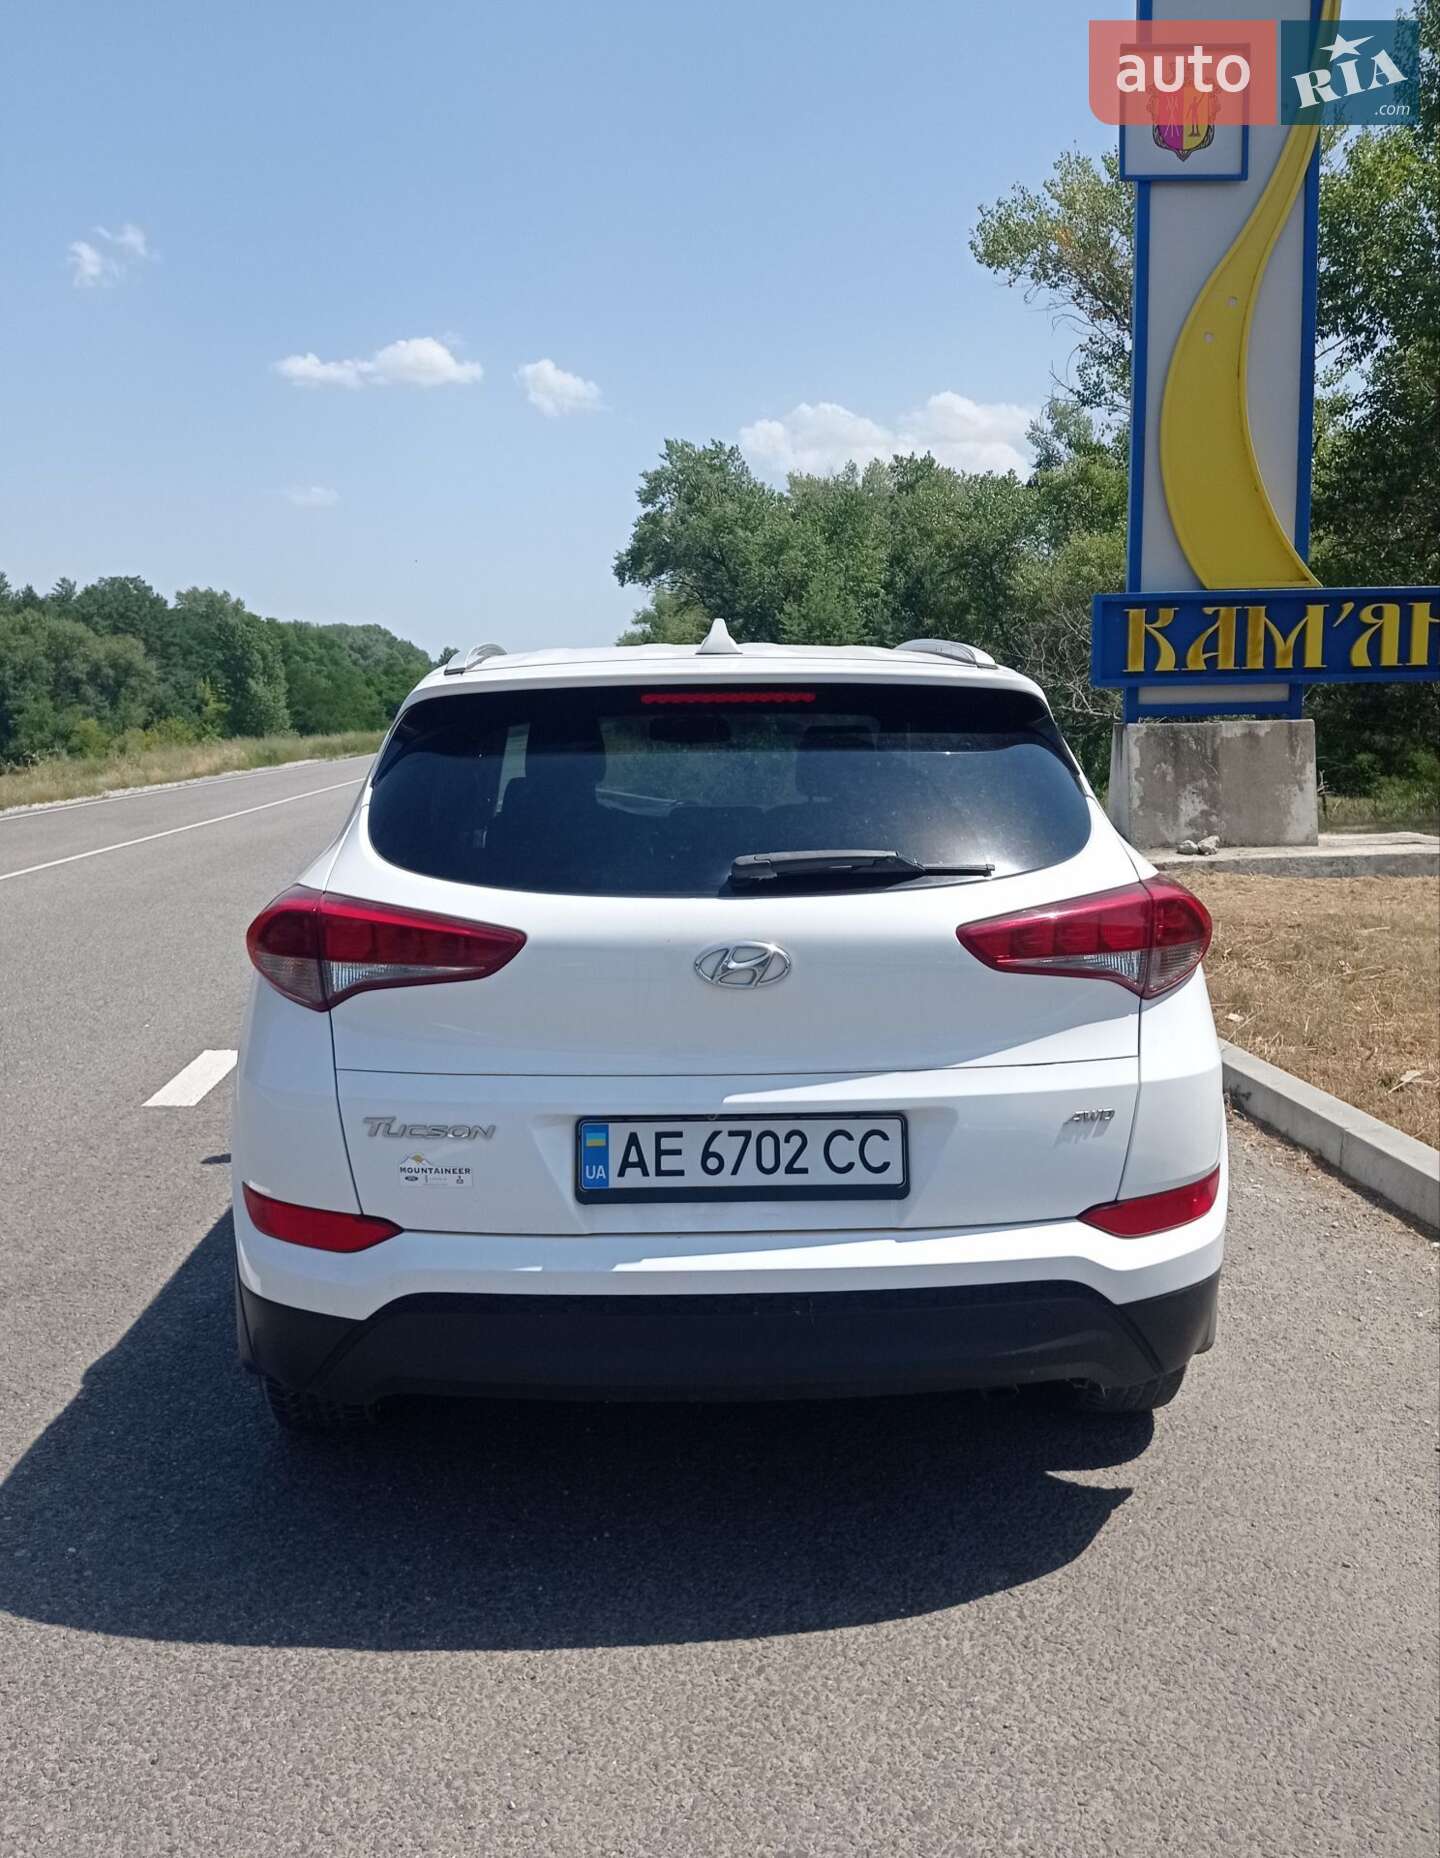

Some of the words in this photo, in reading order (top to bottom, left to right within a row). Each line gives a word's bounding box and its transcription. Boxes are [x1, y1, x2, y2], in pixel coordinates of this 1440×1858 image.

[617, 1131, 685, 1178] AE
[700, 1129, 809, 1176] 6702
[823, 1128, 891, 1175] CC
[586, 1165, 606, 1179] UA
